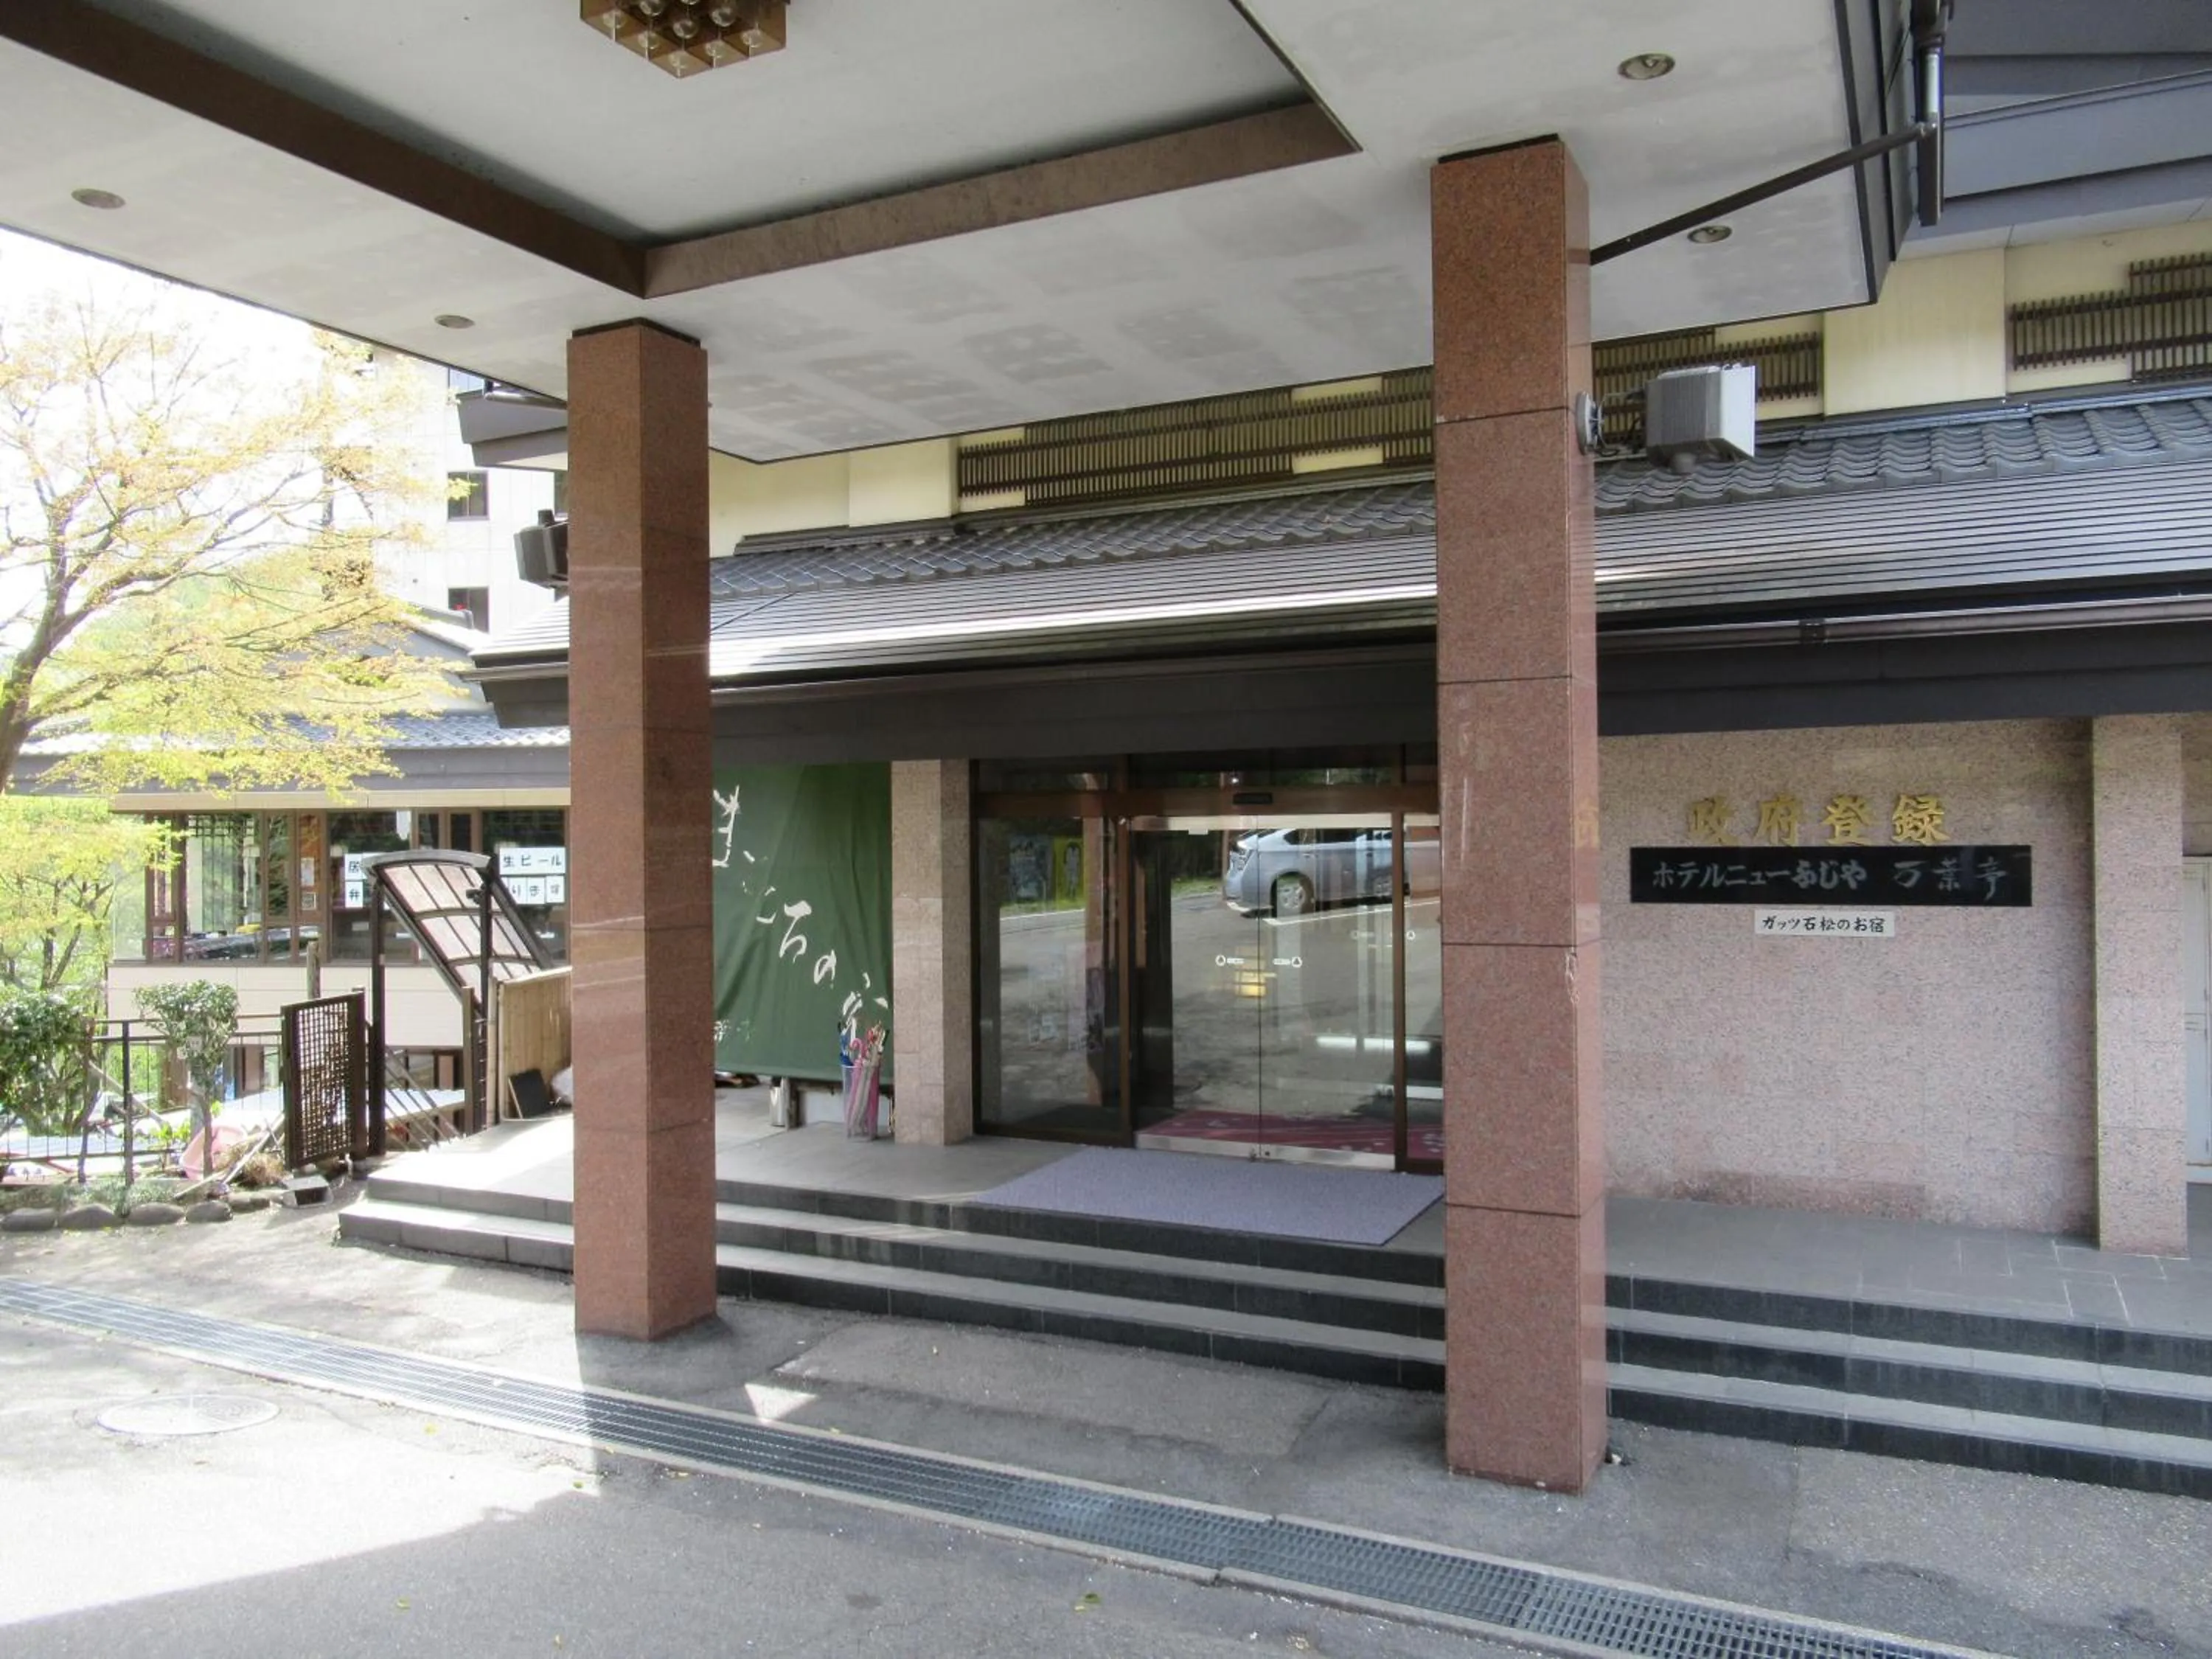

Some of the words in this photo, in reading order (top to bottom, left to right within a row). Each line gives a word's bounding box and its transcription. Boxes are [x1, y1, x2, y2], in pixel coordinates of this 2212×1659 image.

[1688, 794, 1950, 846] 政府登録
[1761, 915, 1886, 934] ガッツ石松のお宿
